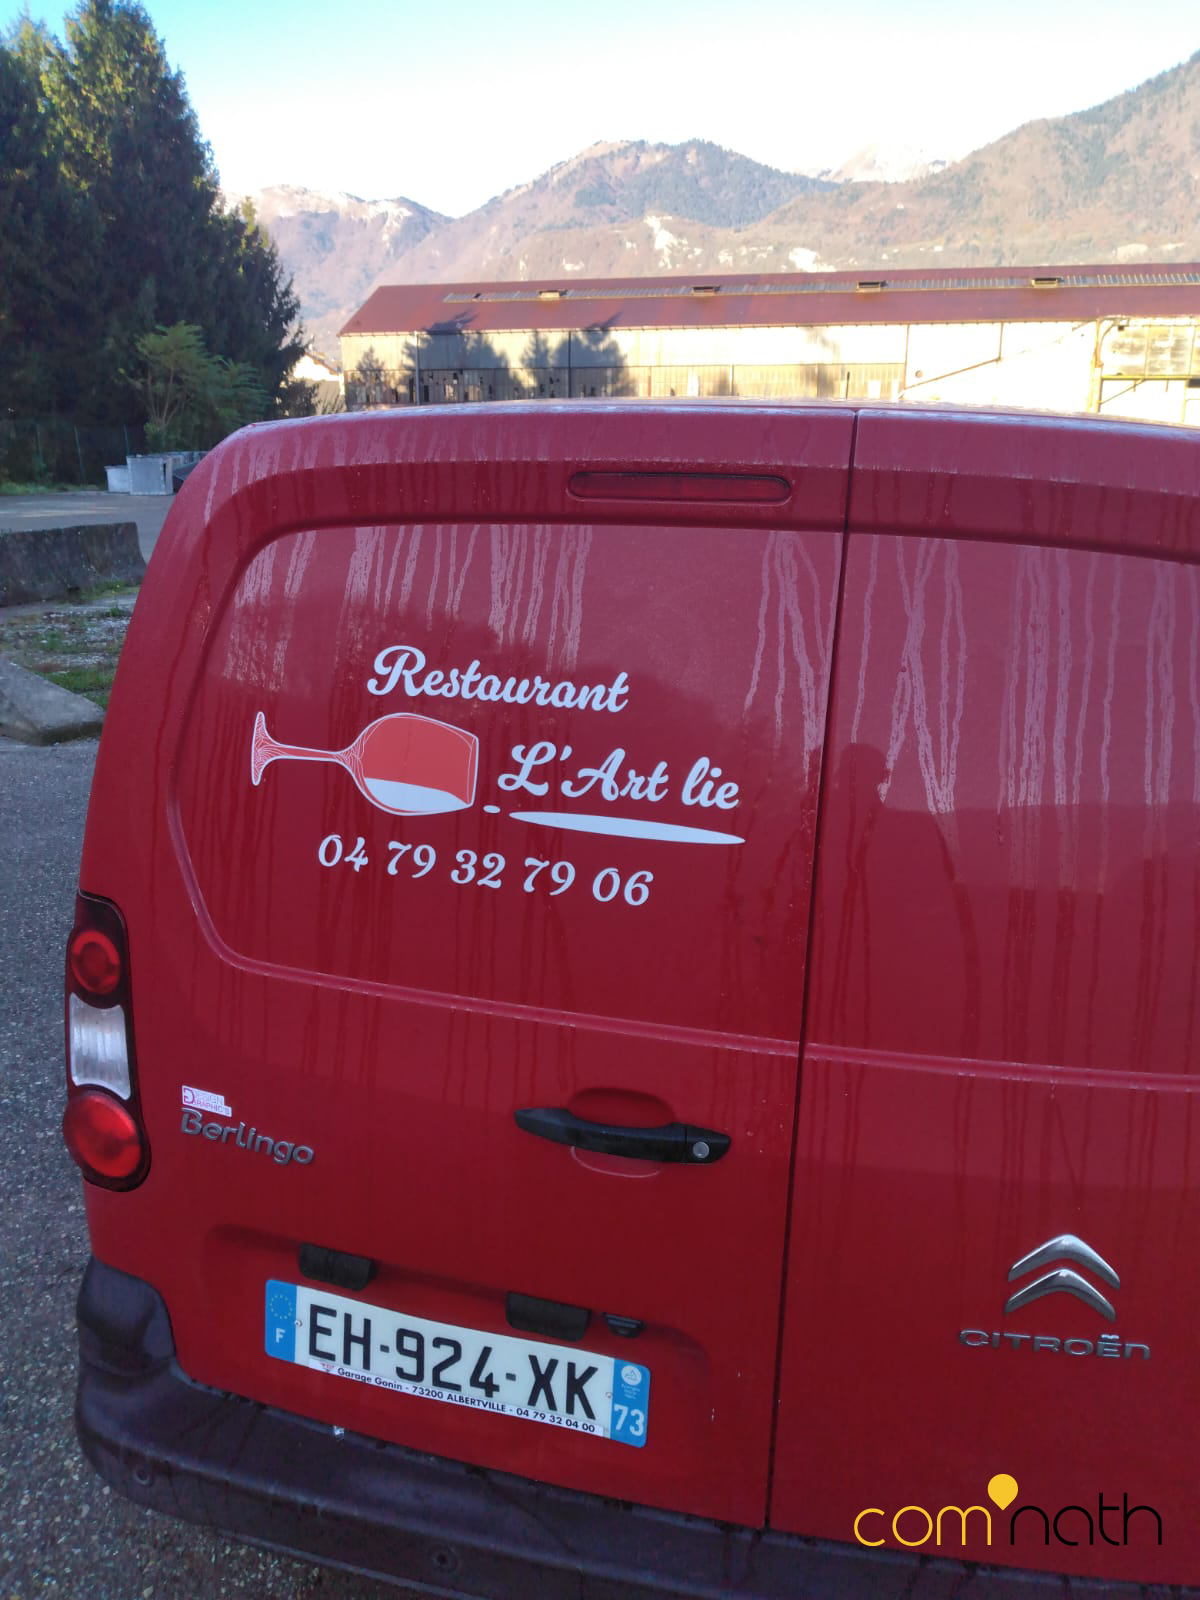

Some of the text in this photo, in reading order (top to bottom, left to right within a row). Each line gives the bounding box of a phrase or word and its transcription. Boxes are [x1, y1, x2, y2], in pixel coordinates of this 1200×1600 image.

[367, 645, 629, 713] Restaurant
[498, 741, 740, 810] L'Art lie
[318, 834, 654, 906] 04 79 32 79 06
[181, 1107, 314, 1165] Berlingo
[275, 1328, 285, 1343] F
[308, 1304, 598, 1420] EH-924-XK
[337, 1367, 372, 1384] Garage
[412, 1385, 444, 1399] 73200
[446, 1393, 507, 1412] ALBERTVILLE
[516, 1407, 530, 1417] 04
[533, 1410, 546, 1421] 79
[549, 1414, 562, 1425] 32
[565, 1418, 579, 1429] 04
[582, 1423, 596, 1433] 00
[614, 1404, 645, 1437] 73
